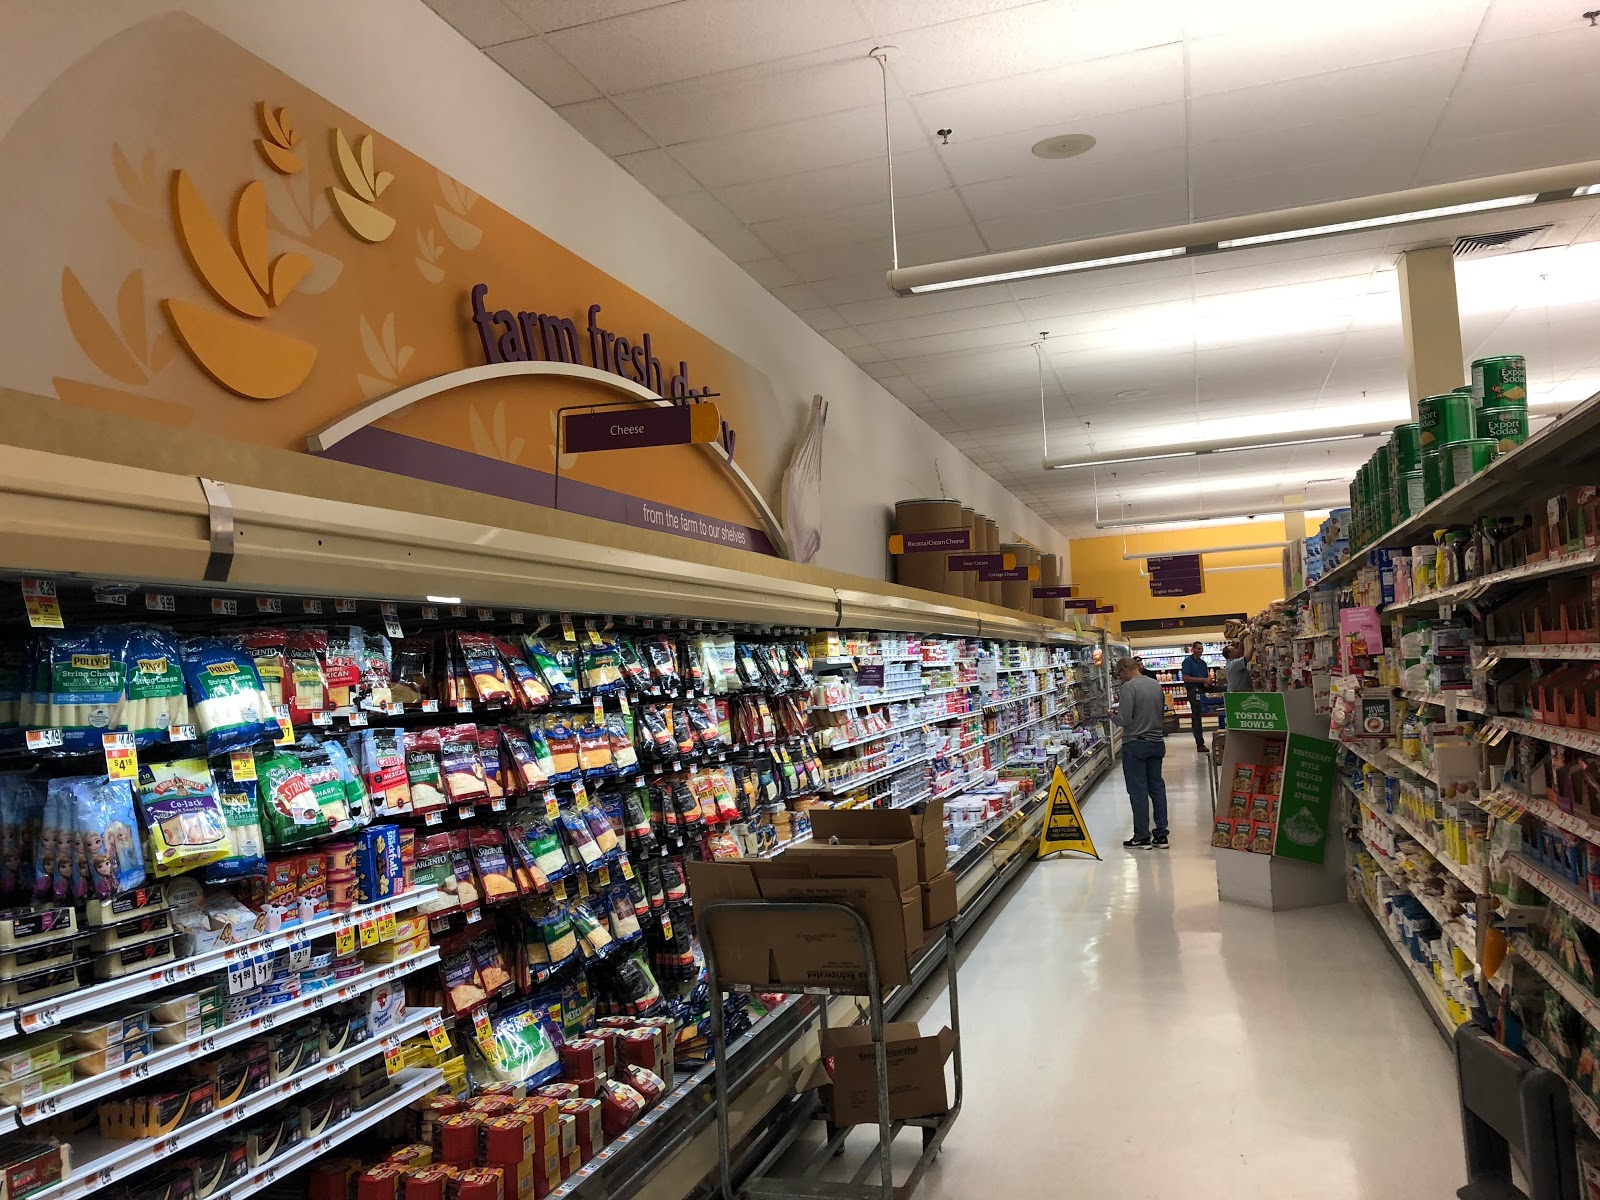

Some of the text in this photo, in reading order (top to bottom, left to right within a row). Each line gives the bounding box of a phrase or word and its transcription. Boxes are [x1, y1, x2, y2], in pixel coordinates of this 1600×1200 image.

[472, 283, 664, 398] farm fresh
[1488, 420, 1519, 430] Export
[610, 425, 645, 436] Cheese
[1489, 428, 1519, 436] Sodas
[643, 503, 746, 544] from the farm to our shelves
[62, 670, 88, 679] String
[325, 671, 349, 679] XICAN
[1234, 711, 1278, 720] TOSTADA
[1240, 721, 1274, 729] BOWLS
[1293, 748, 1331, 762] RESTAURANT
[1301, 761, 1320, 770] STYLE
[1296, 771, 1323, 781] MEXICAN
[1296, 781, 1320, 792] SALADS
[170, 799, 203, 809] Co-Jack
[807, 970, 855, 979] Refrigerated
